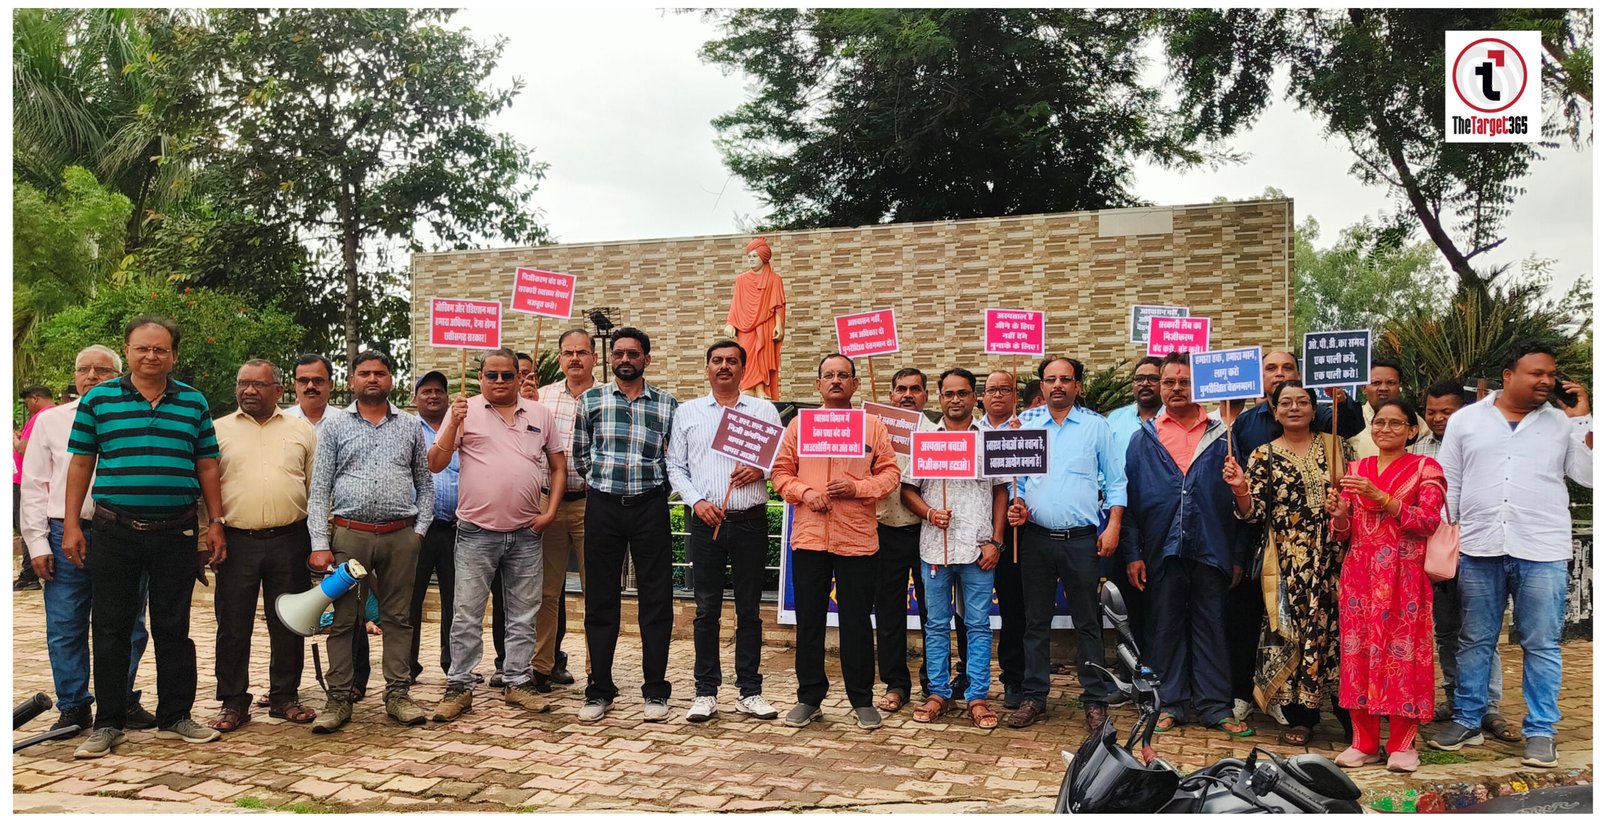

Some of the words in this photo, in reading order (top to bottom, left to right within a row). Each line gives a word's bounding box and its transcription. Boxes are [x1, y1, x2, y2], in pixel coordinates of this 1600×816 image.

[1163, 331, 1194, 341] निजीकरण
[1348, 338, 1365, 347] समय
[1314, 356, 1325, 365] एक
[1326, 352, 1341, 364] पाली
[1343, 352, 1358, 364] करो,
[1228, 365, 1239, 376] करो
[1314, 371, 1325, 380] एक
[1326, 368, 1341, 379] पाली
[920, 441, 946, 451] अस्पताल
[918, 457, 948, 471] निजीकरण
